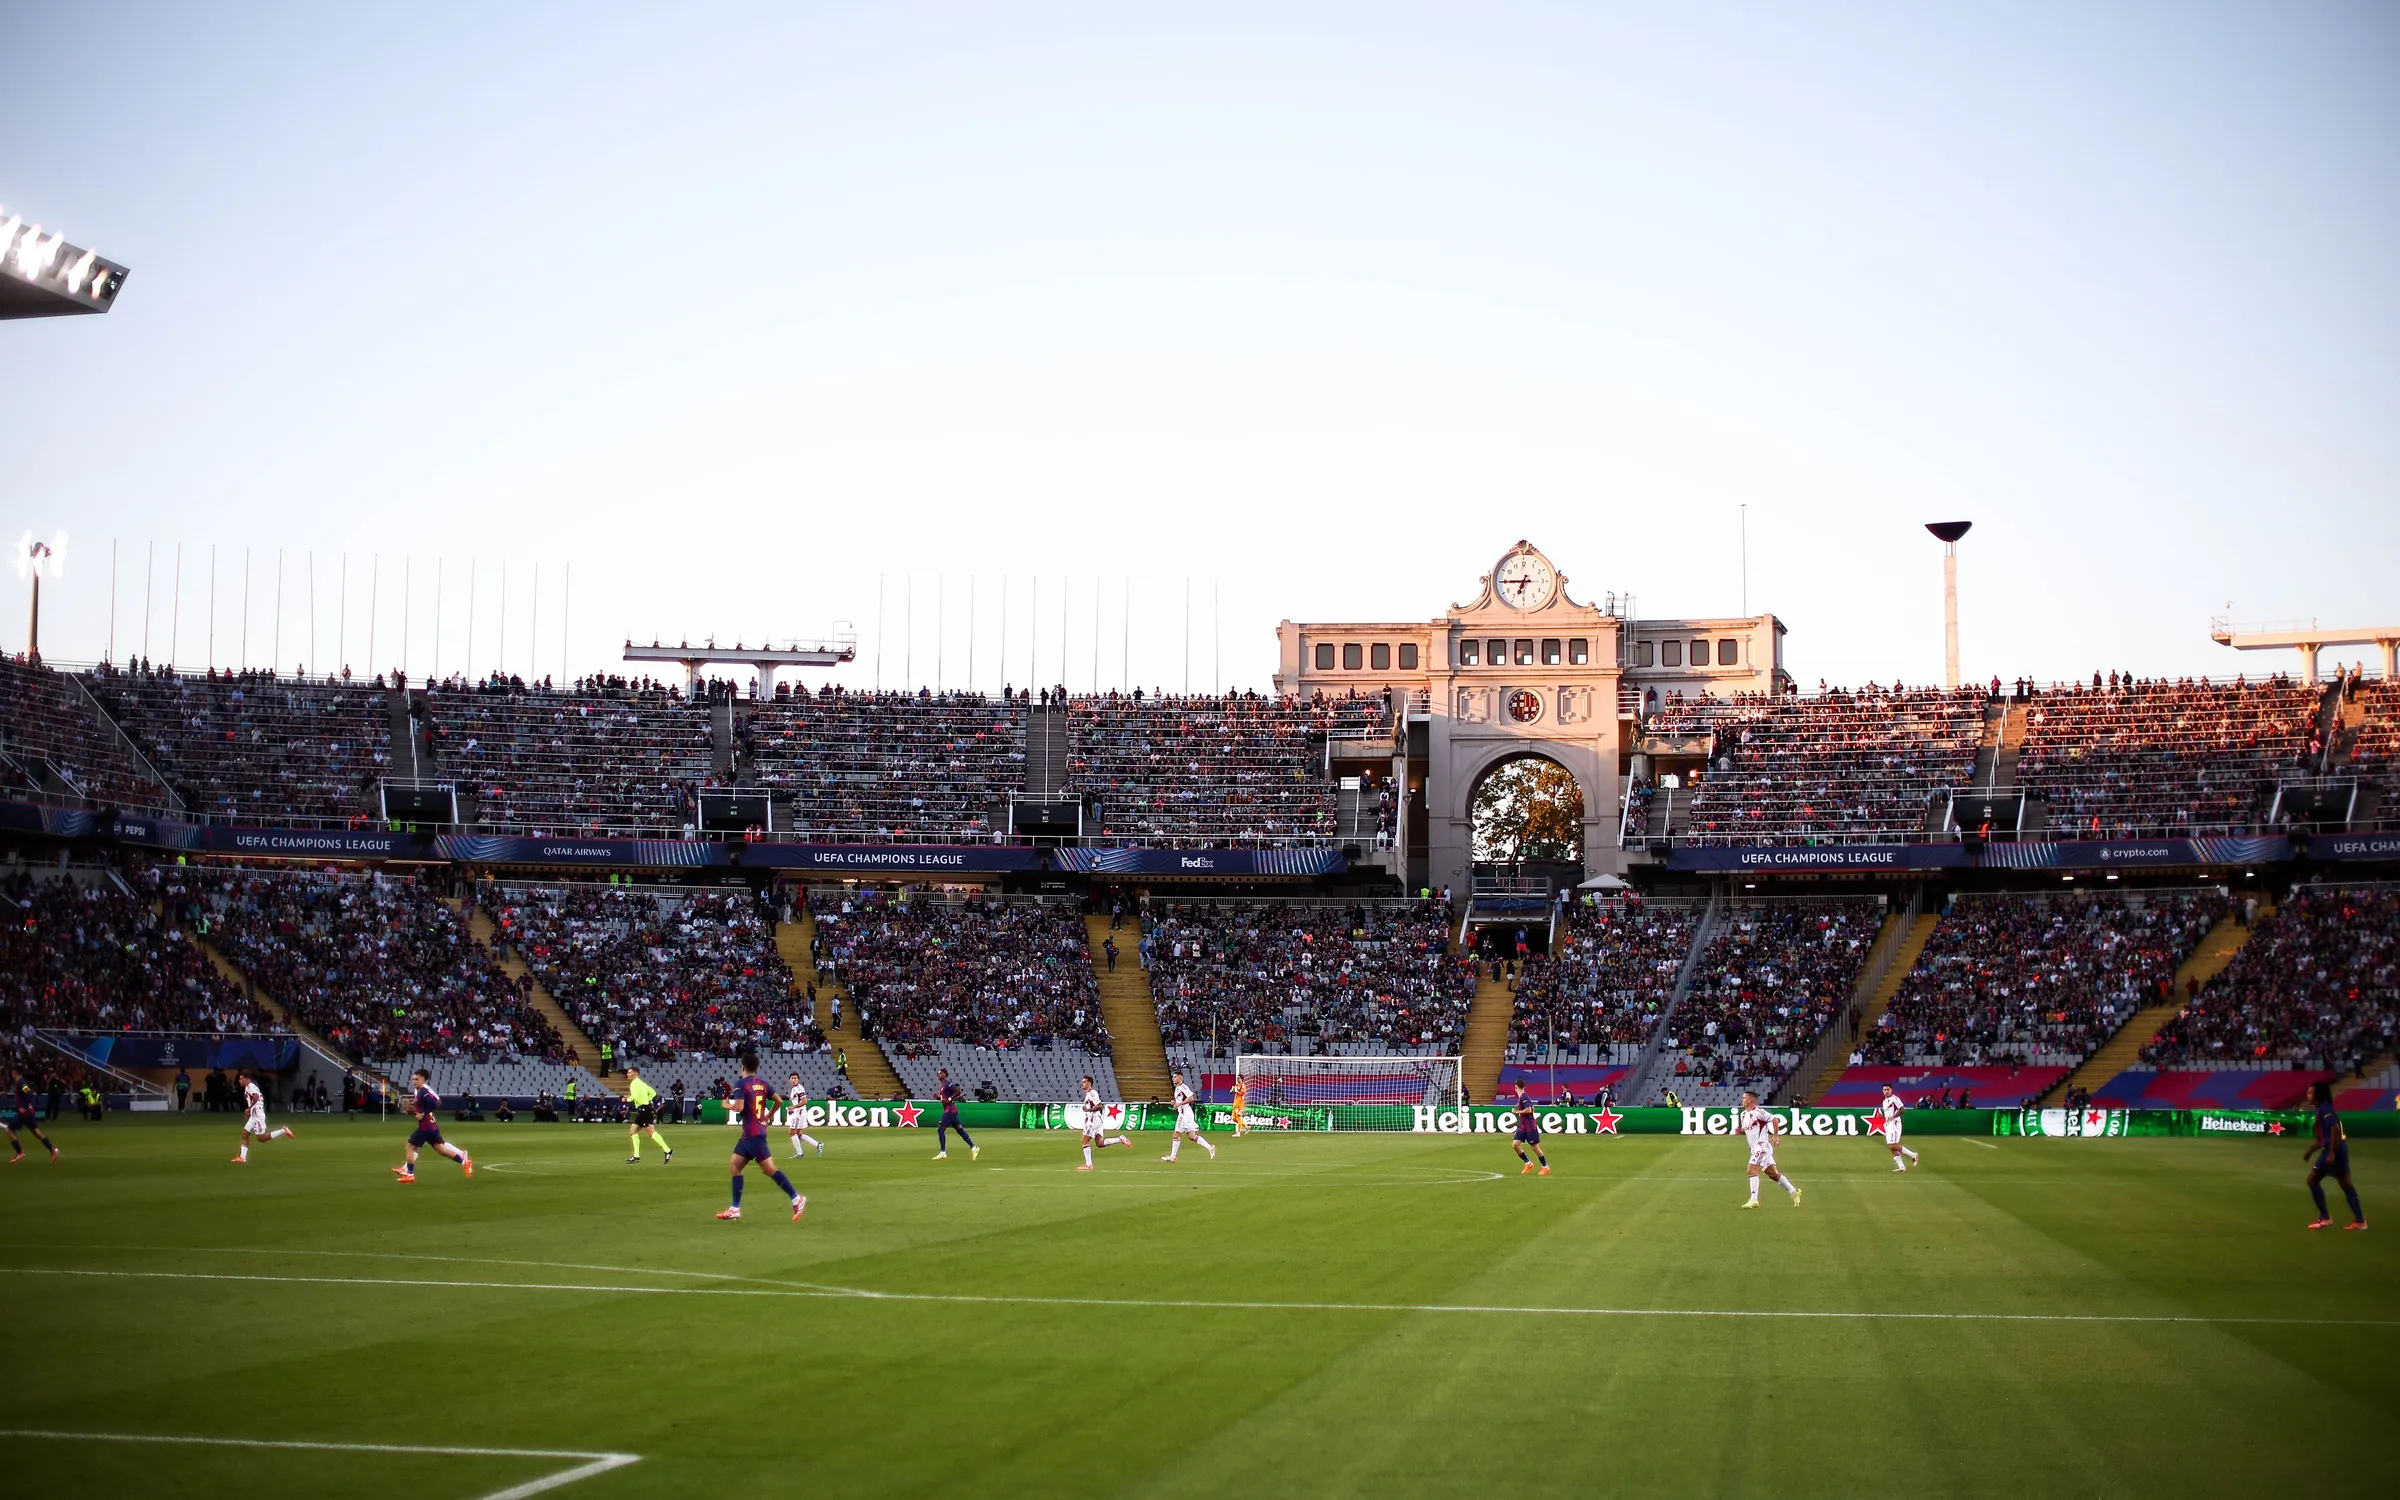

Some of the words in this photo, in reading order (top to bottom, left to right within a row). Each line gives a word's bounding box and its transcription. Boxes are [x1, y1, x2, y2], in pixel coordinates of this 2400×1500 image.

[125, 825, 146, 836] PEPSI
[236, 836, 268, 847] UEFA
[271, 837, 342, 848] CHAMPIONS
[346, 840, 391, 850] LEAGUE
[2333, 842, 2368, 853] UEFA
[543, 847, 573, 856] QATAR
[574, 848, 611, 857] AIRWAYS
[1741, 854, 1772, 863] UEFA
[1775, 853, 1844, 863] CHAMPIONS
[1848, 852, 1893, 862] LEAGUE
[2113, 848, 2169, 858] crypto.com
[814, 853, 844, 862] UEFA
[847, 853, 915, 864] CHAMPIONS
[919, 855, 963, 864] LEAGUE
[1181, 857, 1214, 868] FedEx
[755, 1095, 763, 1119] 5
[726, 1100, 890, 1127] ieken
[1214, 1111, 1274, 1126] Heeken
[1412, 1105, 1587, 1133] Heineen
[1680, 1107, 1858, 1135] Heieken
[2202, 1116, 2265, 1132] Heineken
